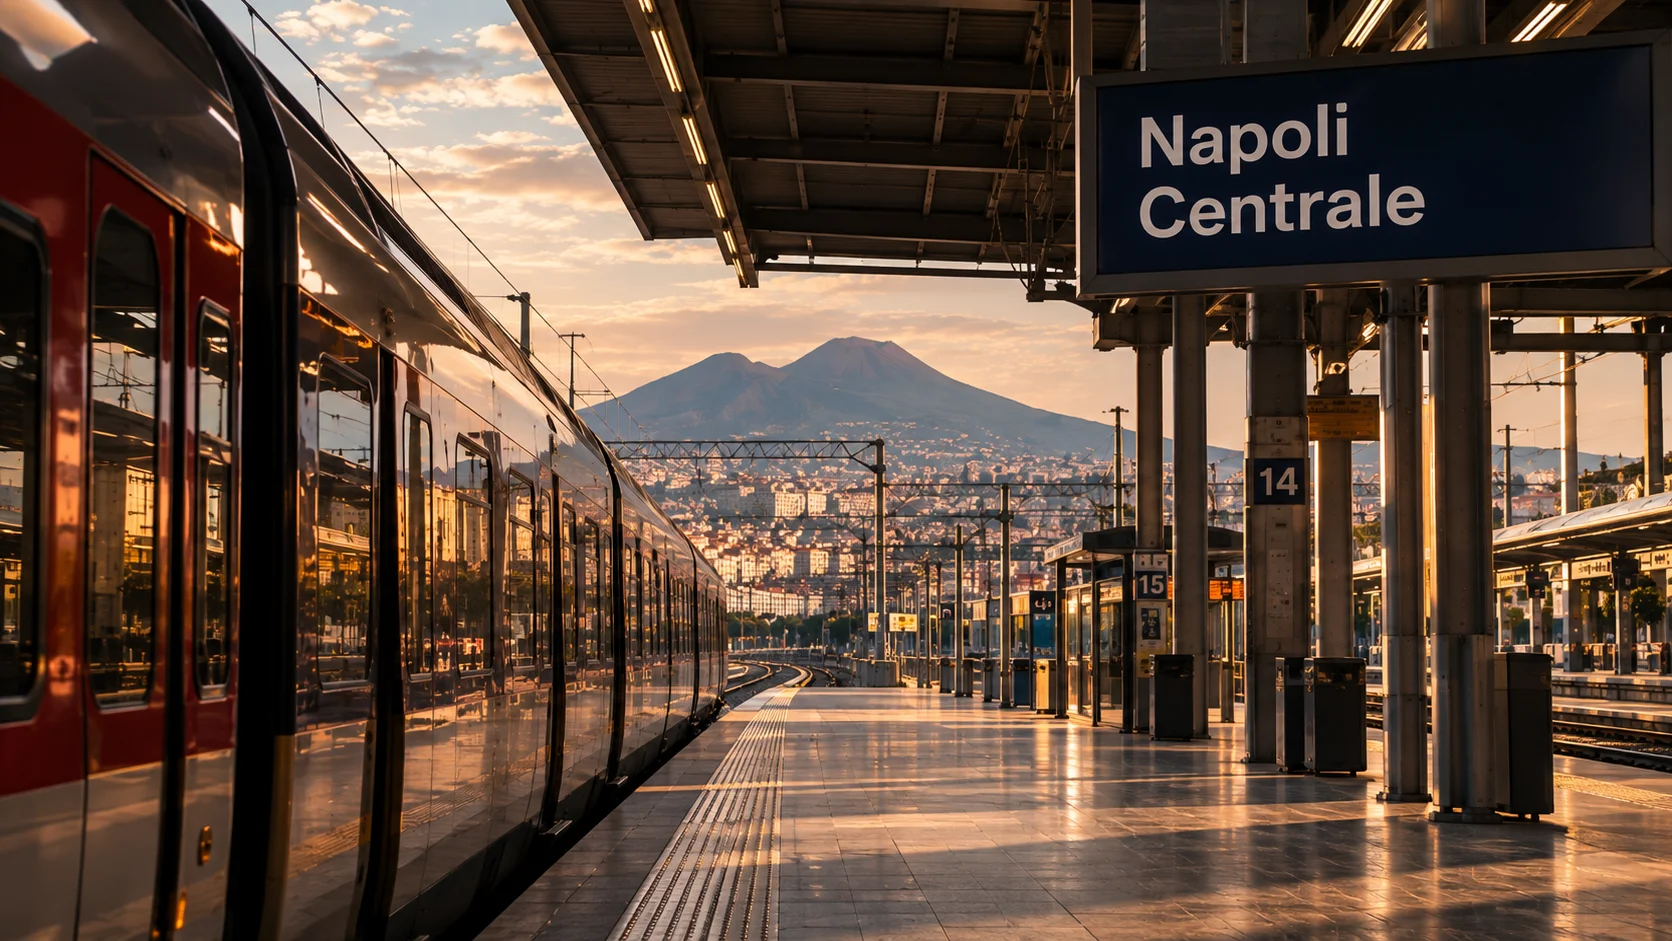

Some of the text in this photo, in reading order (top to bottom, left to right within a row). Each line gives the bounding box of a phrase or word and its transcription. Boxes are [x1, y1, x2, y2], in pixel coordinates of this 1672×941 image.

[1141, 102, 1348, 175] Napoli
[1139, 173, 1426, 239] Centrale
[1259, 467, 1298, 496] 14
[1139, 575, 1164, 594] 15
